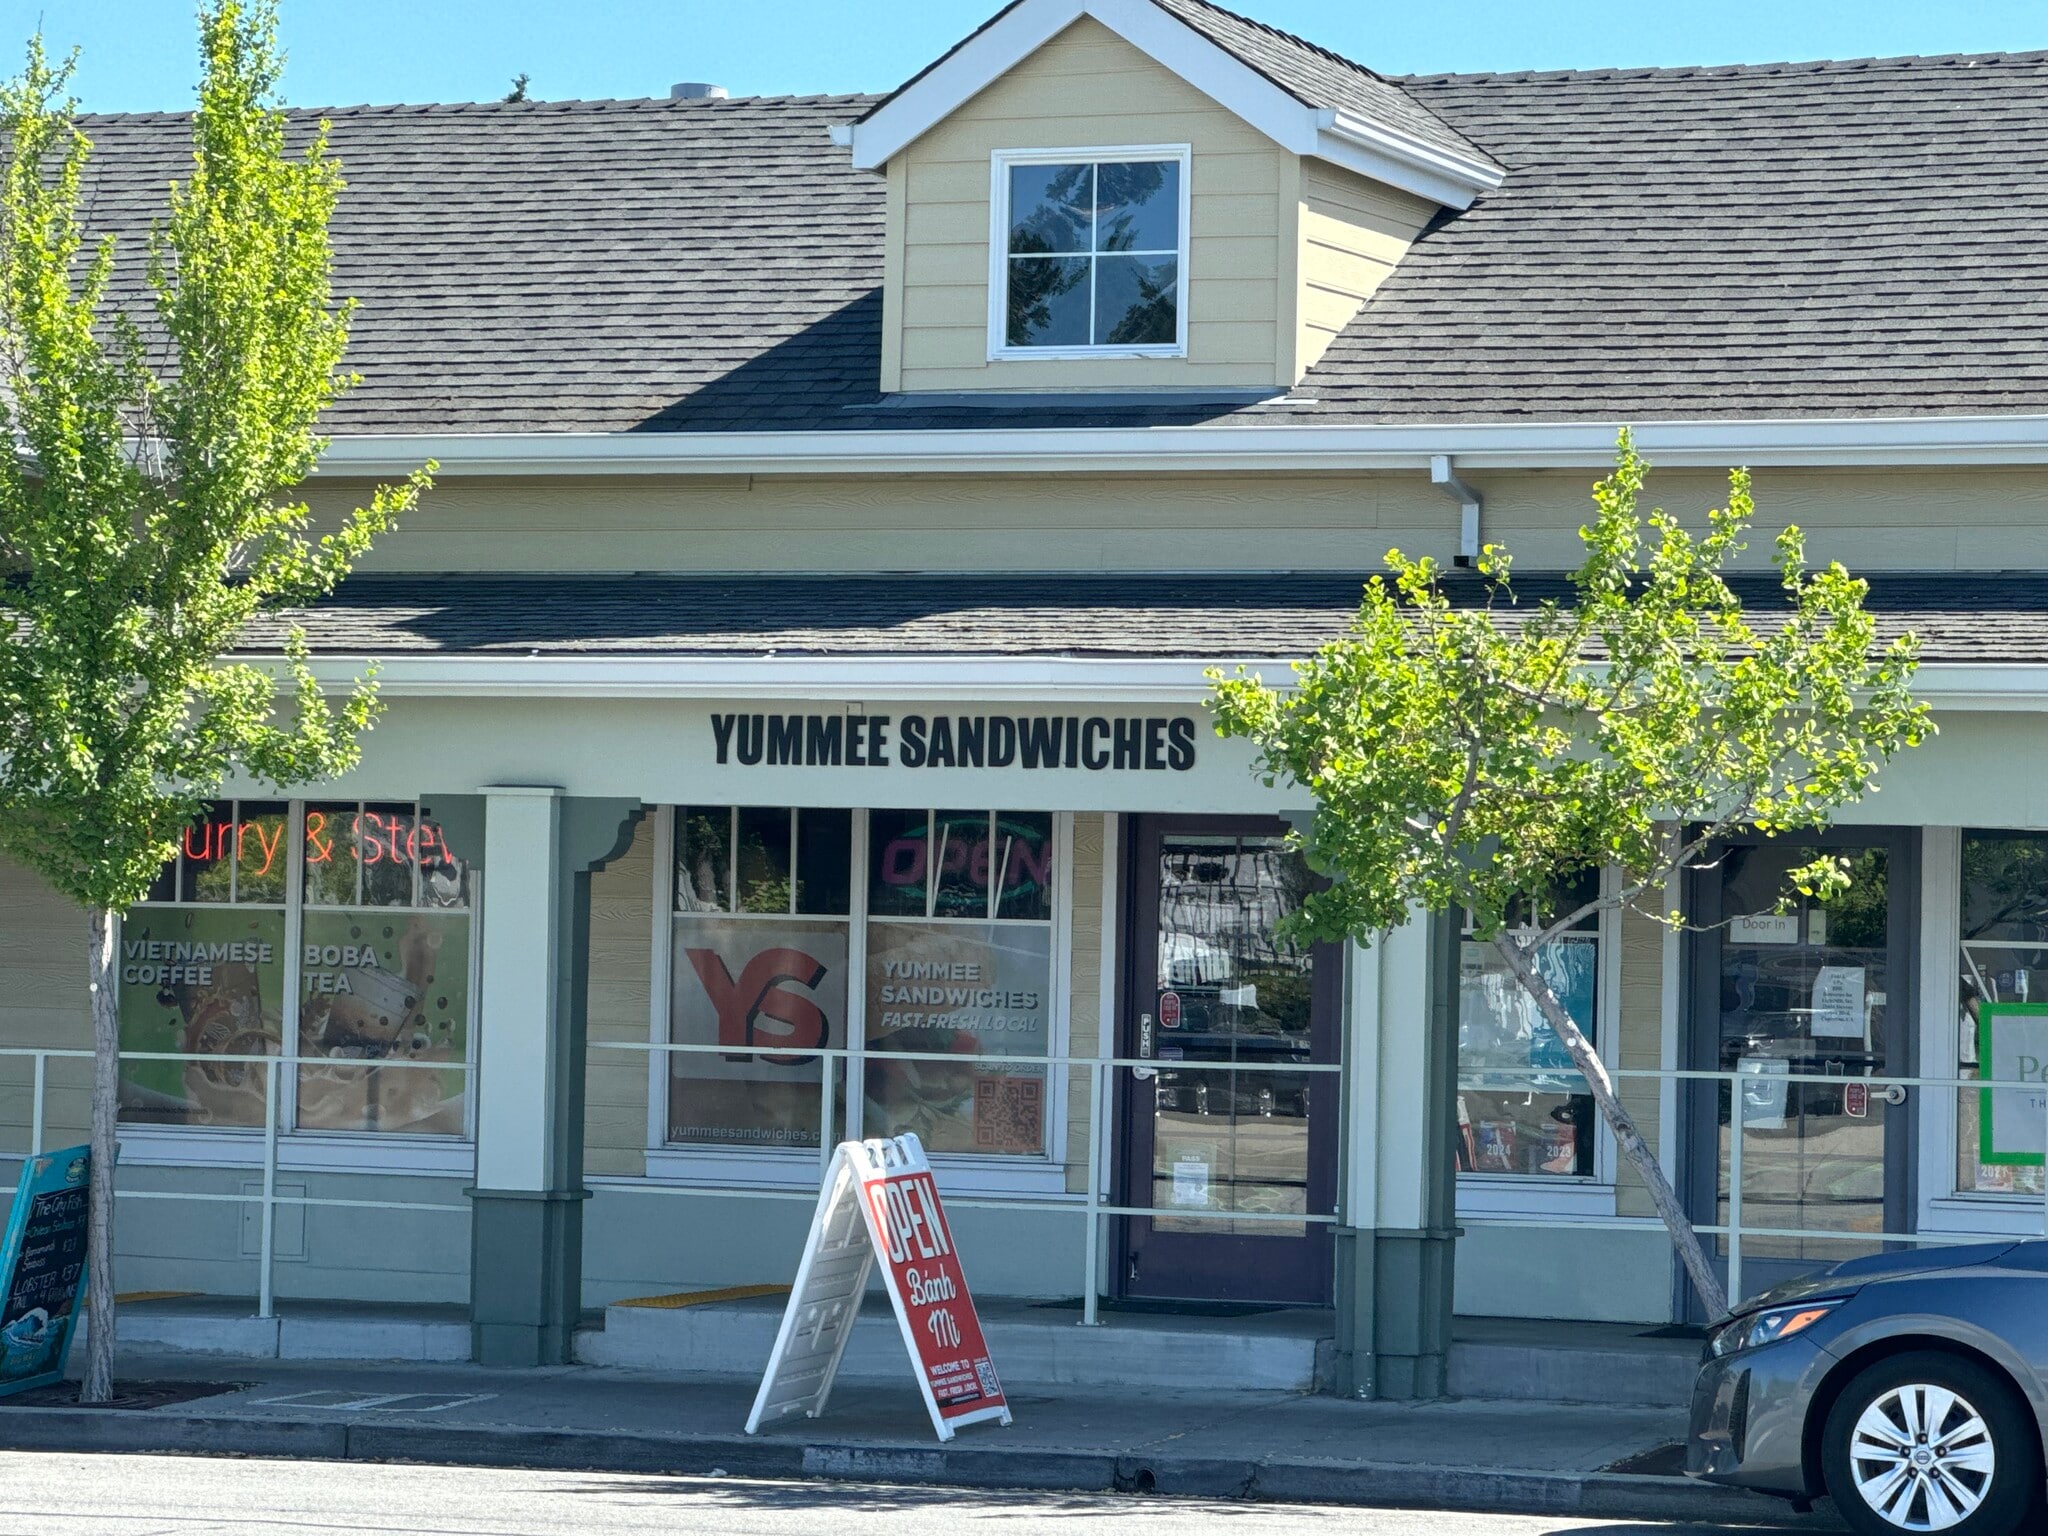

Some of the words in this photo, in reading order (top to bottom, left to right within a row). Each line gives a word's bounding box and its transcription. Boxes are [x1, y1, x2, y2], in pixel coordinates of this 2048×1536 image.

[711, 714, 889, 767] YUMMEE
[899, 715, 1196, 771] SANDWICHES
[183, 821, 283, 876] urry
[306, 811, 333, 864] &
[882, 839, 1052, 886] OPEN
[1742, 918, 1770, 930] Door
[1775, 919, 1786, 930] In
[123, 940, 273, 963] VIETNAMESE
[304, 944, 380, 968] BOBA
[122, 964, 213, 986] COFFEE
[302, 971, 353, 995] TEA
[881, 961, 981, 982] YUMMEE
[880, 985, 1039, 1010] SANDWICHES
[1142, 1016, 1150, 1048] PUSH
[671, 1124, 846, 1142] yummeesandwiches.cm
[1486, 1143, 1511, 1156] 2024
[1547, 1144, 1573, 1157] 2023
[869, 1177, 950, 1264] OPEN
[14, 1271, 58, 1296] LOBSTER
[906, 1264, 957, 1307] Bánh
[930, 1361, 960, 1375] WELCOME
[960, 1359, 970, 1370] TO
